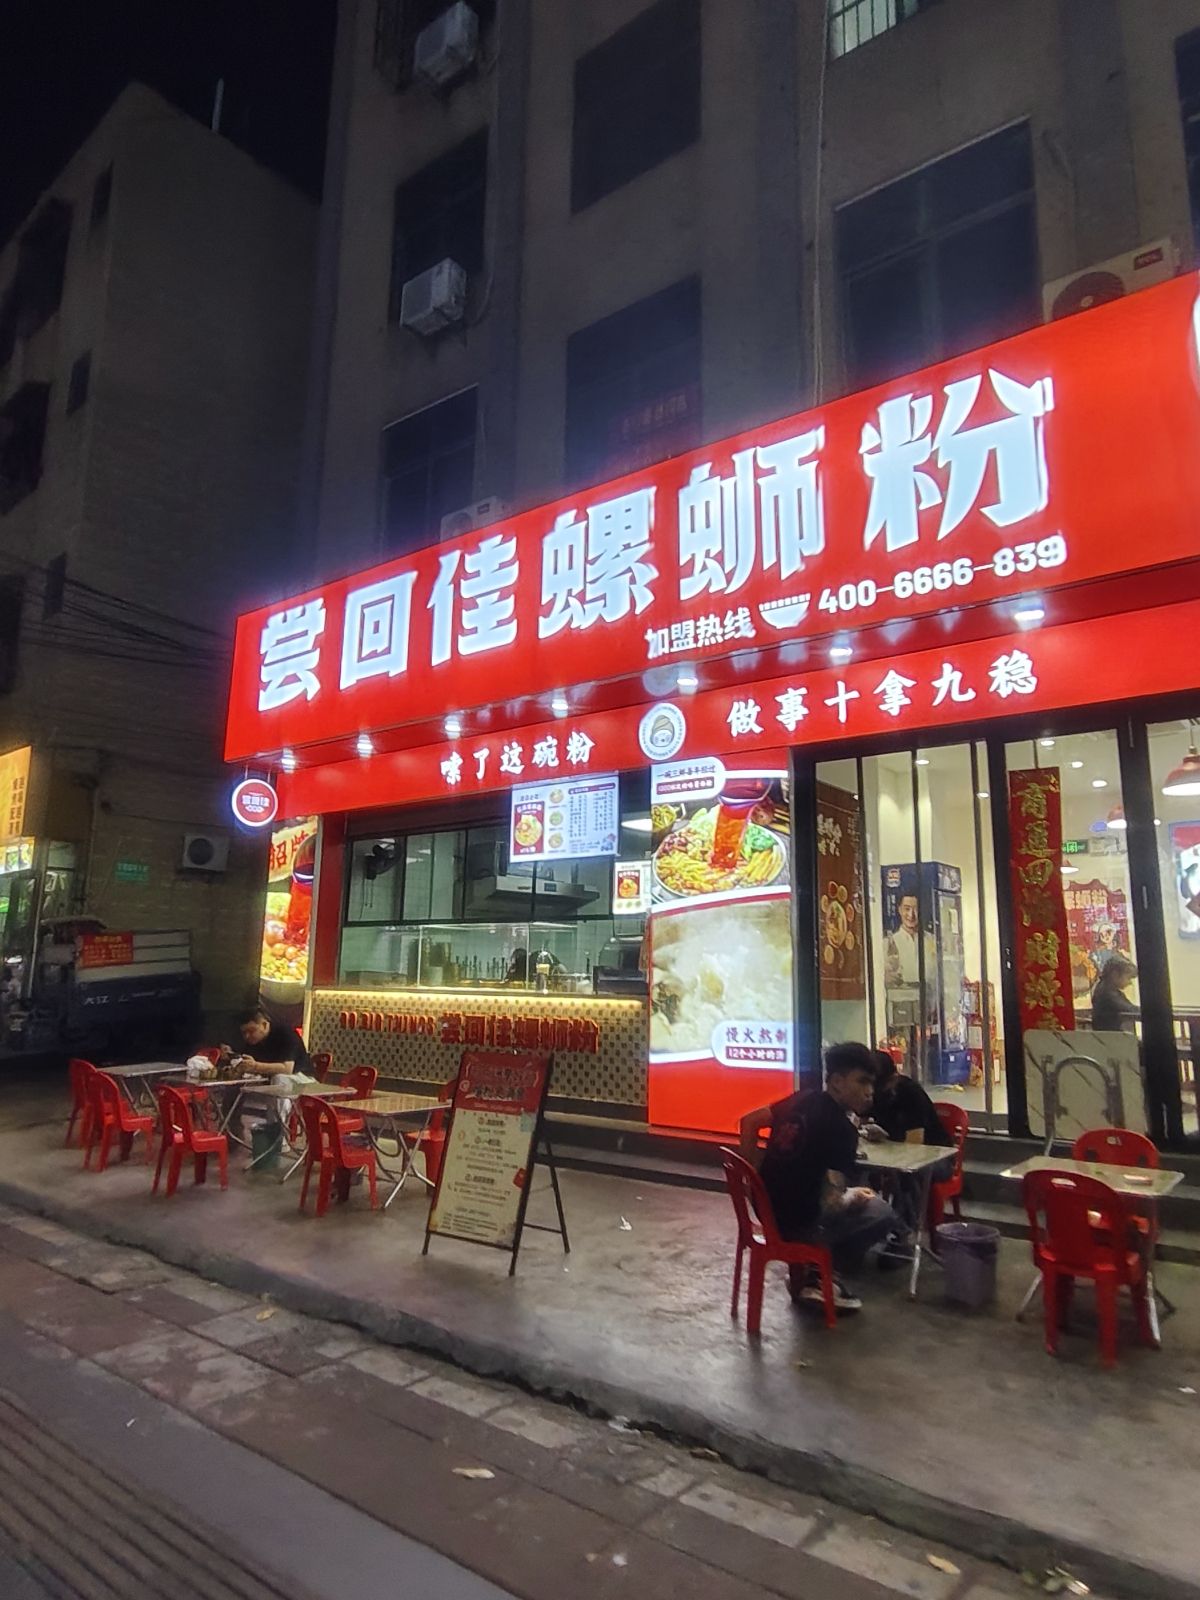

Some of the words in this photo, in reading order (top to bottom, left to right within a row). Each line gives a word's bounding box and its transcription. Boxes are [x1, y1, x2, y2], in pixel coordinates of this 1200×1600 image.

[258, 369, 1054, 712] 尝回佳螺蛳粉
[819, 534, 1068, 615] 400-6666-839
[644, 610, 756, 660] 加盟热线
[727, 650, 1039, 738] 做事十拿九稳
[439, 731, 596, 786] 嗦了这碗粉
